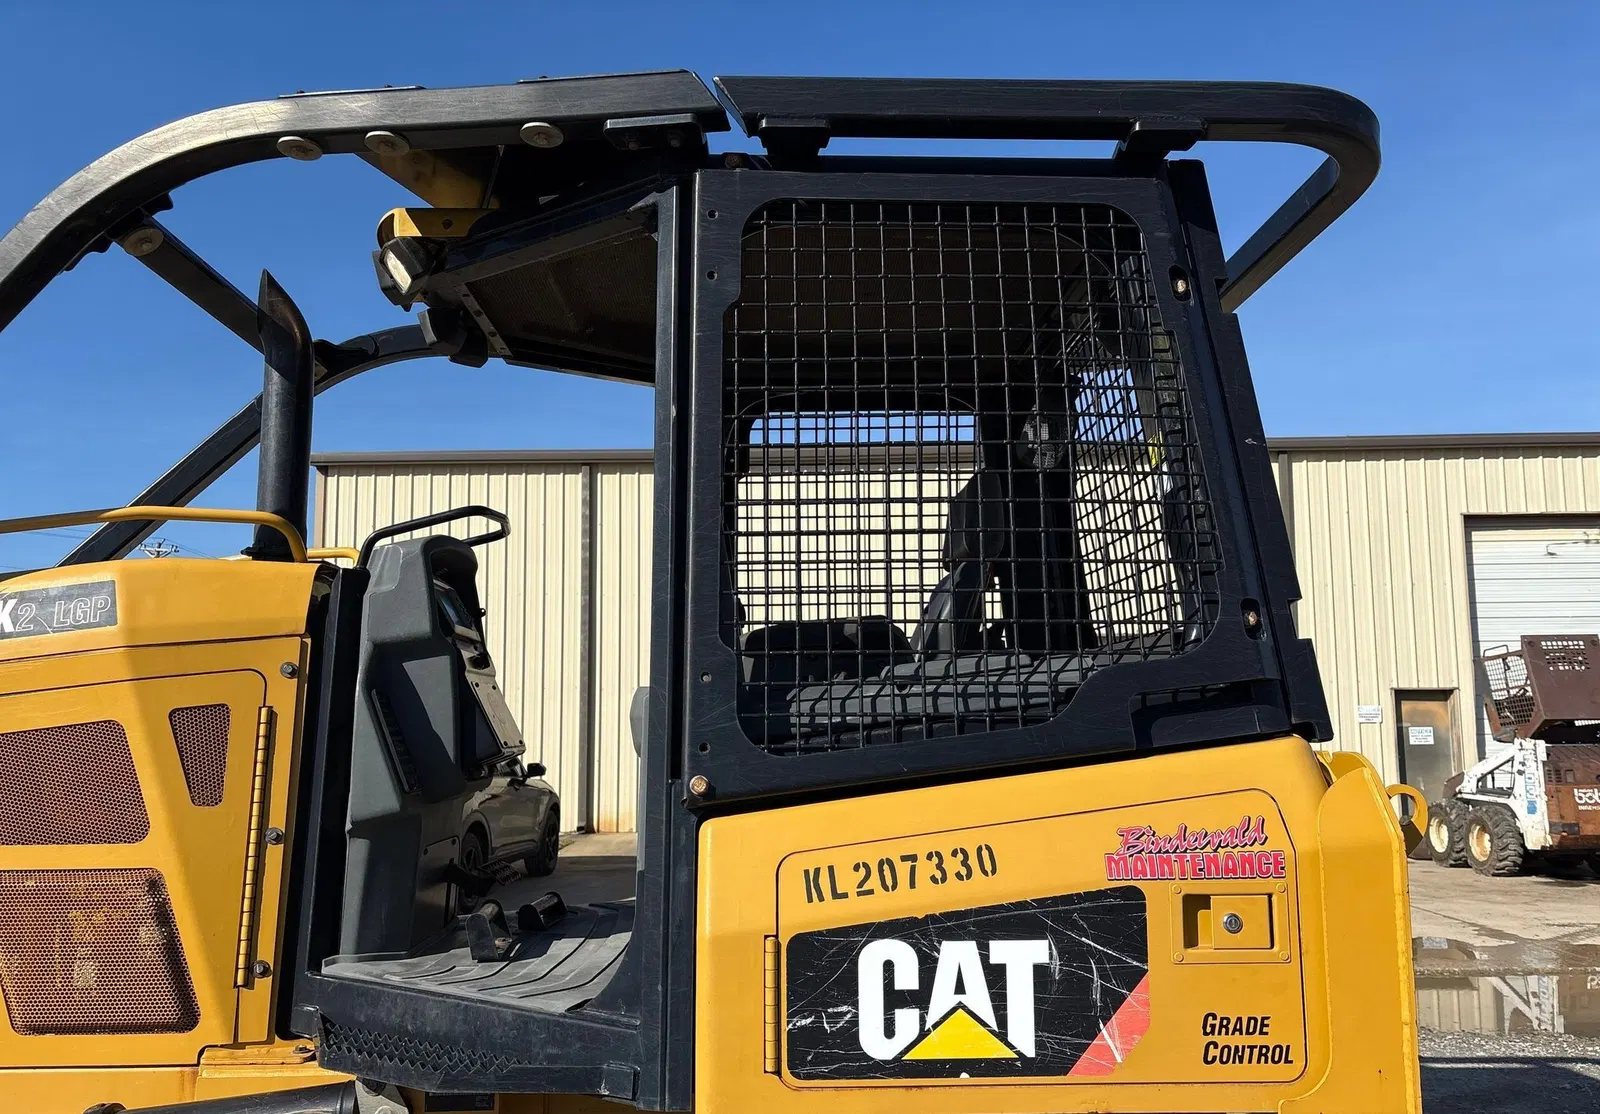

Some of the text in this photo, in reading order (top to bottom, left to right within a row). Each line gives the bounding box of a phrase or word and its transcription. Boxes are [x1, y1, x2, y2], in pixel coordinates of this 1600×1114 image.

[53, 595, 111, 627] LGP
[1115, 815, 1268, 857] Bindewald
[803, 843, 998, 904] KL207330
[1104, 851, 1287, 880] MAINTENANCE
[858, 938, 1050, 1061] CAT
[1202, 1012, 1271, 1037] GRADE
[1203, 1040, 1294, 1065] CONTROL
